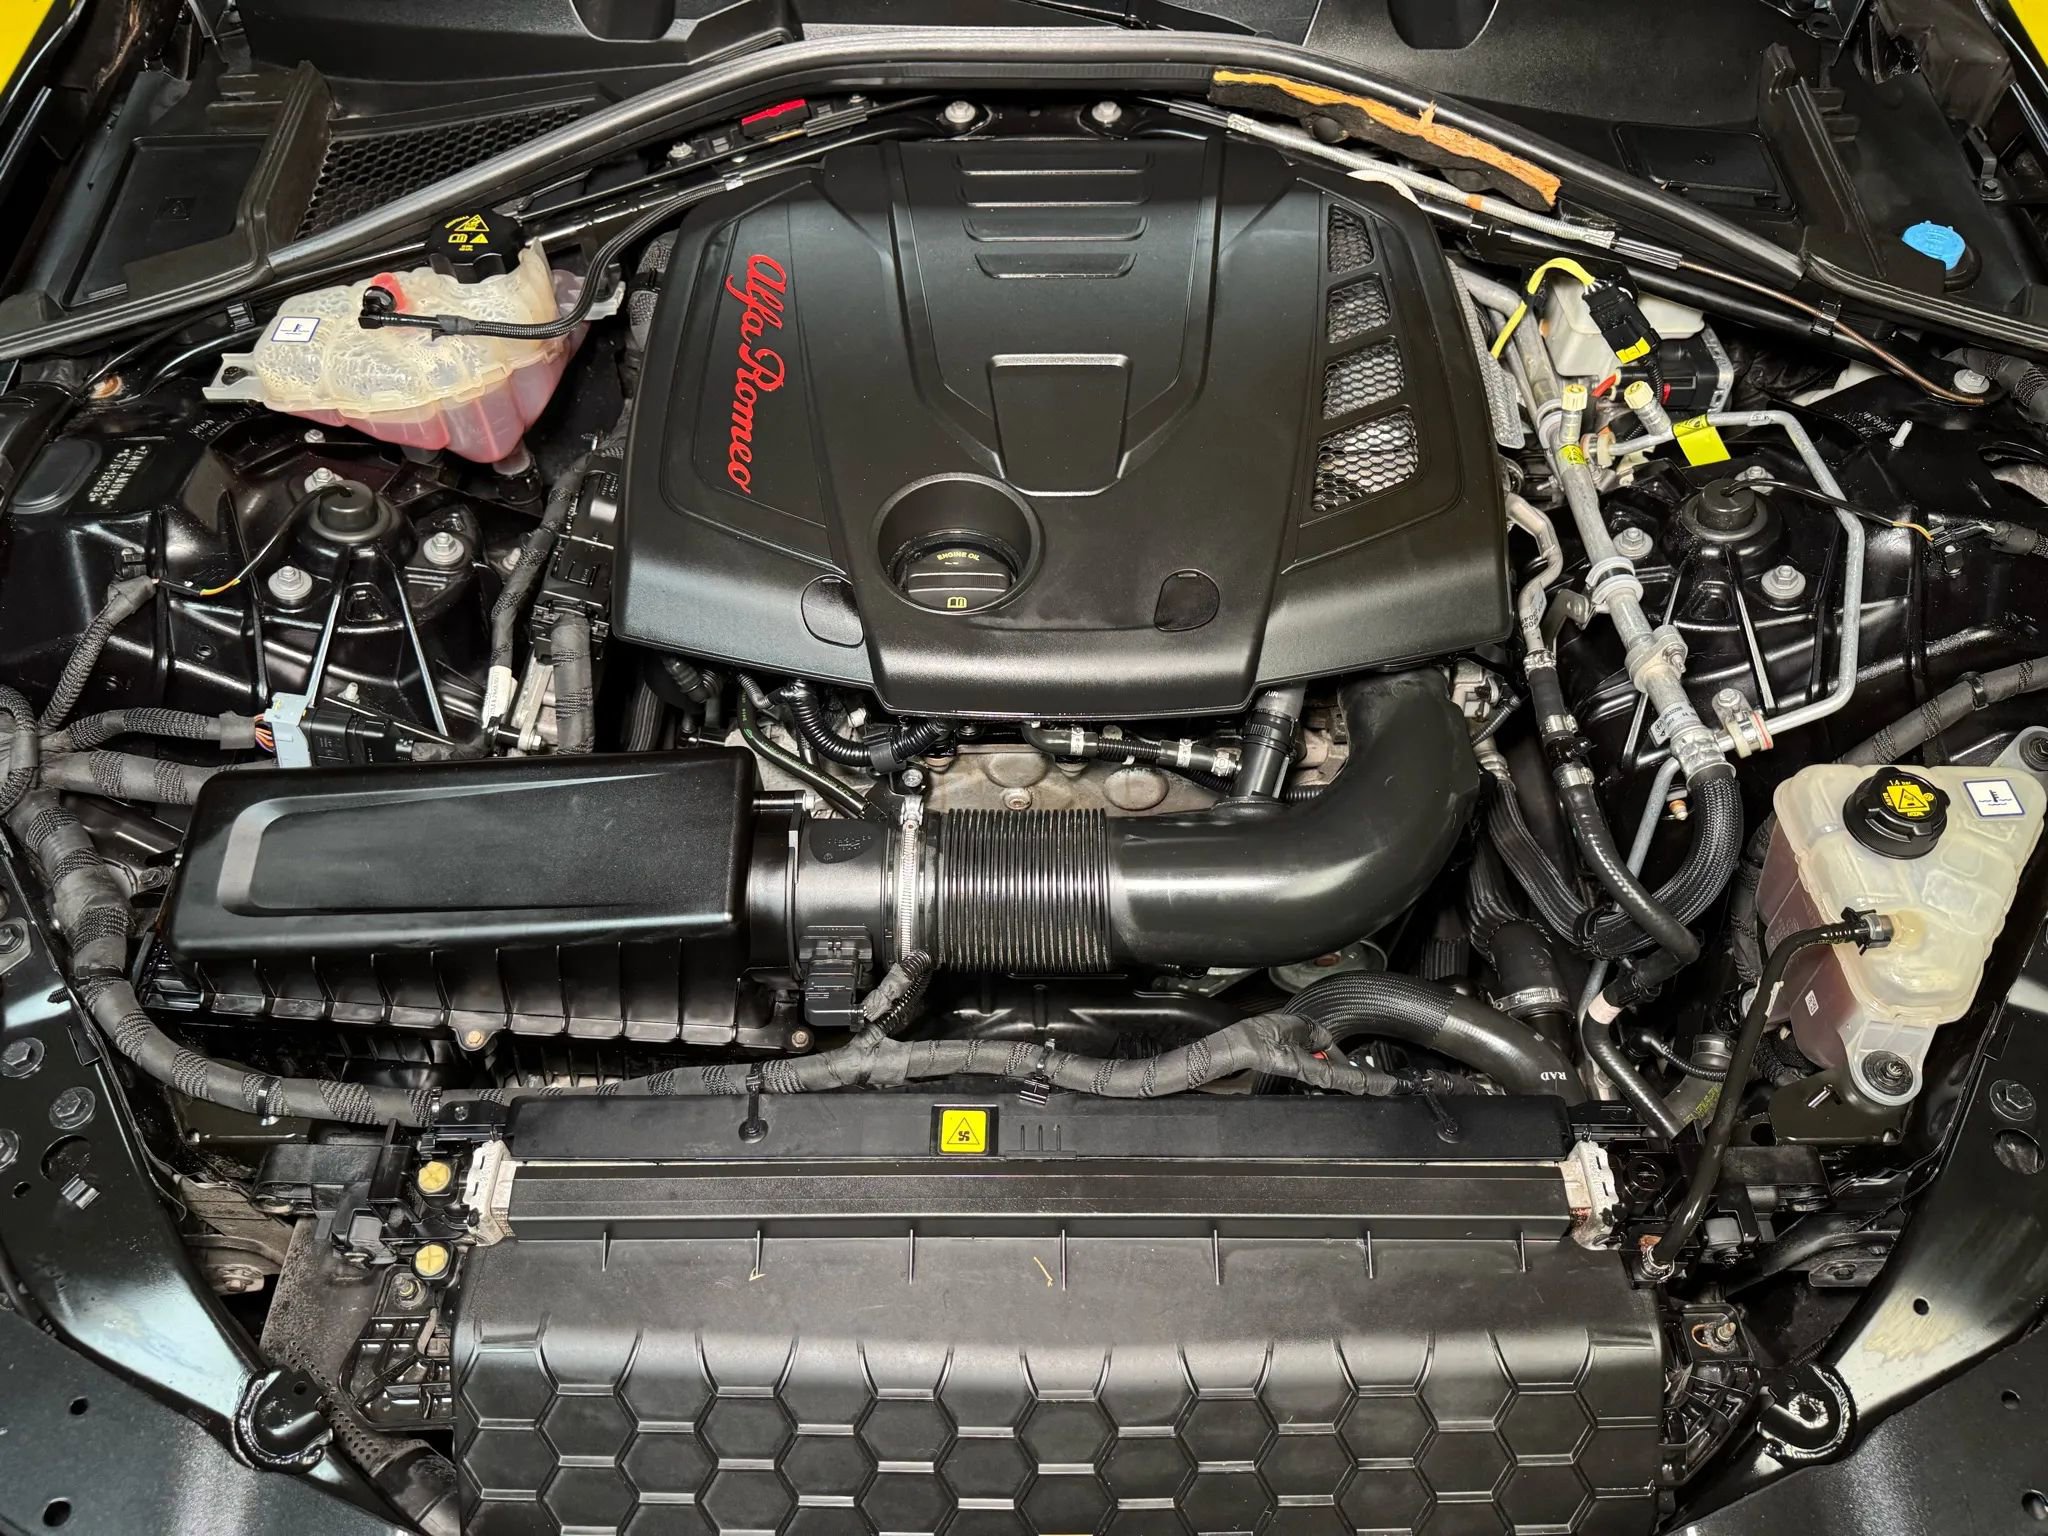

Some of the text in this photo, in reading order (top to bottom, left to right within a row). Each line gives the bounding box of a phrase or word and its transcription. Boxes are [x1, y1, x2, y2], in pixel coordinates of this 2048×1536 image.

[725, 254, 788, 494] Alfa Romeo
[937, 552, 966, 560] ENGINE
[1541, 1072, 1567, 1080] RAD
